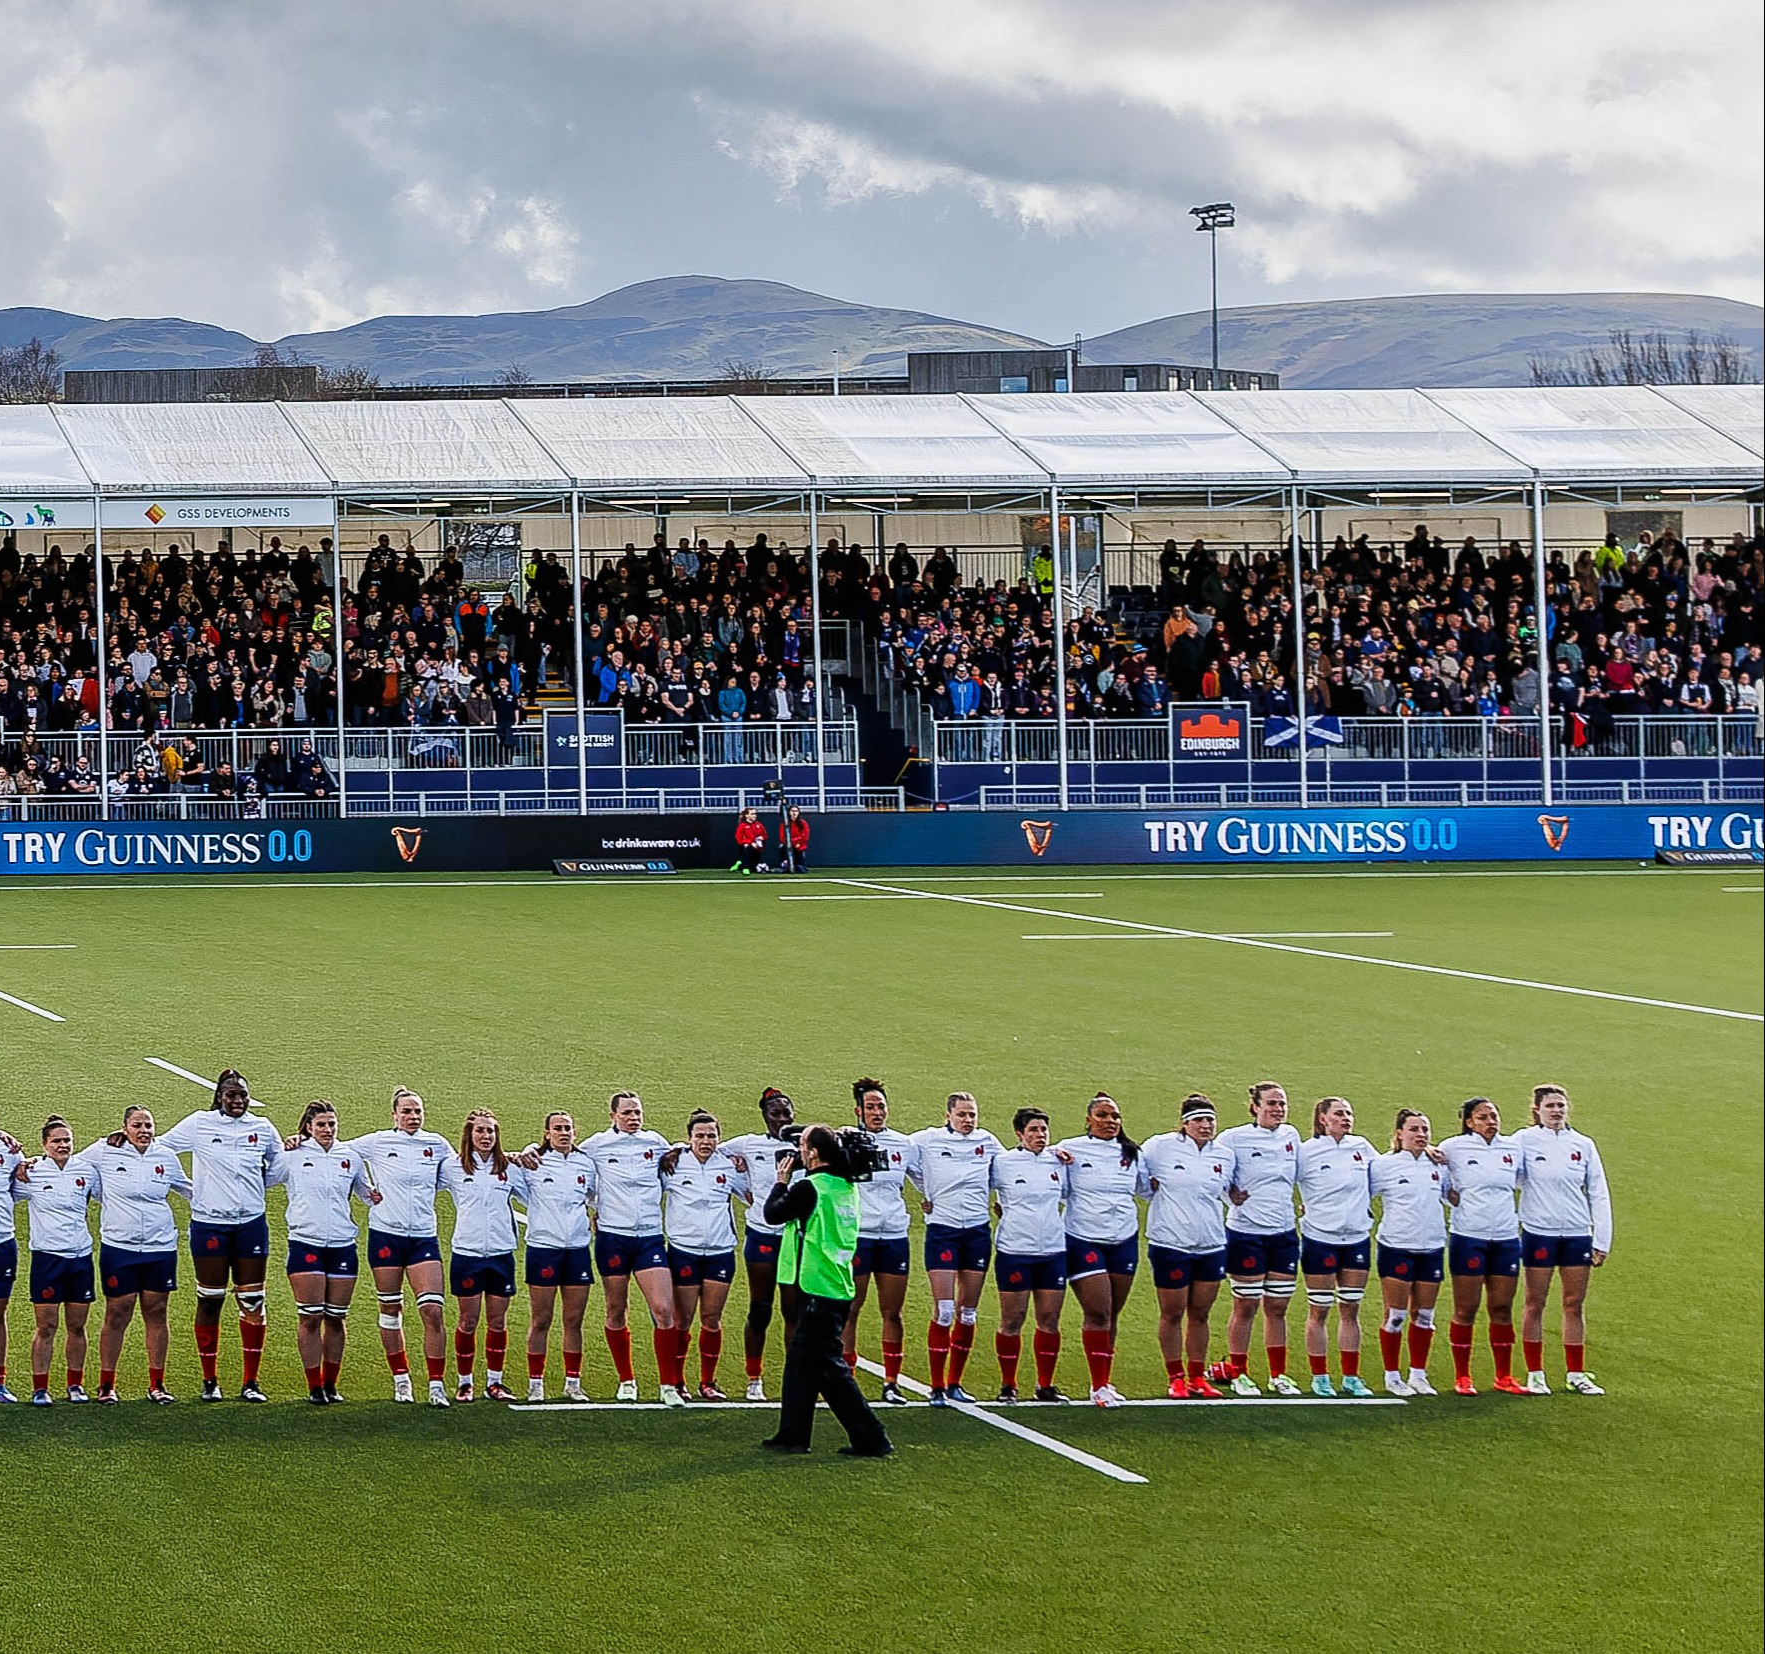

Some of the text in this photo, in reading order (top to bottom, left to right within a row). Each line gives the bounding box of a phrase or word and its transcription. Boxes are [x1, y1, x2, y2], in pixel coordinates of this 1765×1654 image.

[177, 507, 291, 519] GSS DEVELOPMENTS
[1179, 737, 1240, 751] EDINBURGH
[2, 829, 313, 866] TRY GUINNESS 0.0
[1144, 816, 1458, 855] TRY GUINNESS 0.0
[1647, 815, 1713, 848] TRY
